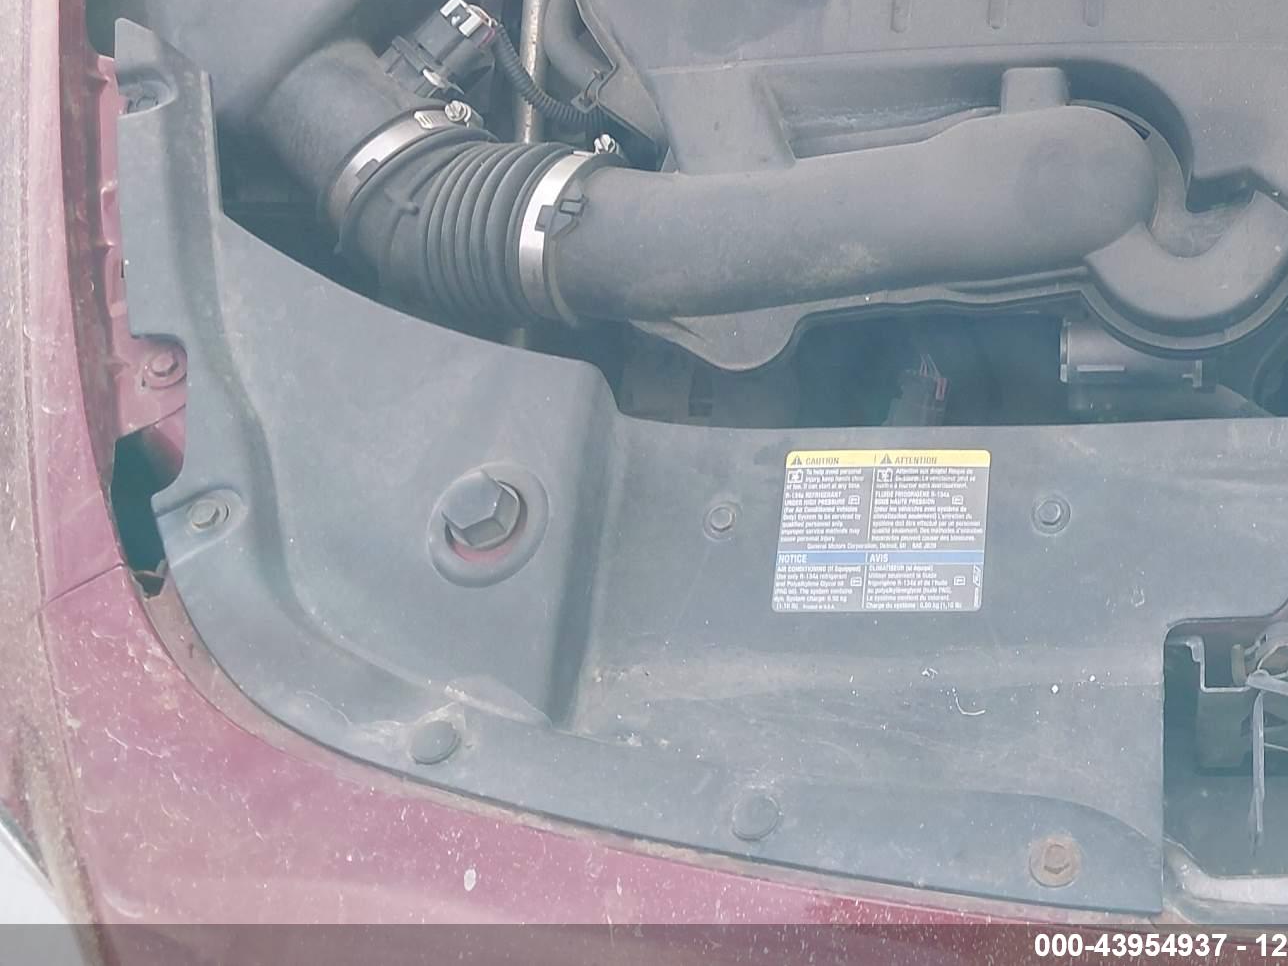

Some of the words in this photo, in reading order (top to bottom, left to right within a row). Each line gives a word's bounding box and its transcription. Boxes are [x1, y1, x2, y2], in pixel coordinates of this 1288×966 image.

[805, 457, 840, 466] CAUTION
[895, 456, 937, 465] ATTENTION
[777, 554, 808, 564] NOTICE
[869, 553, 889, 563] AVIS
